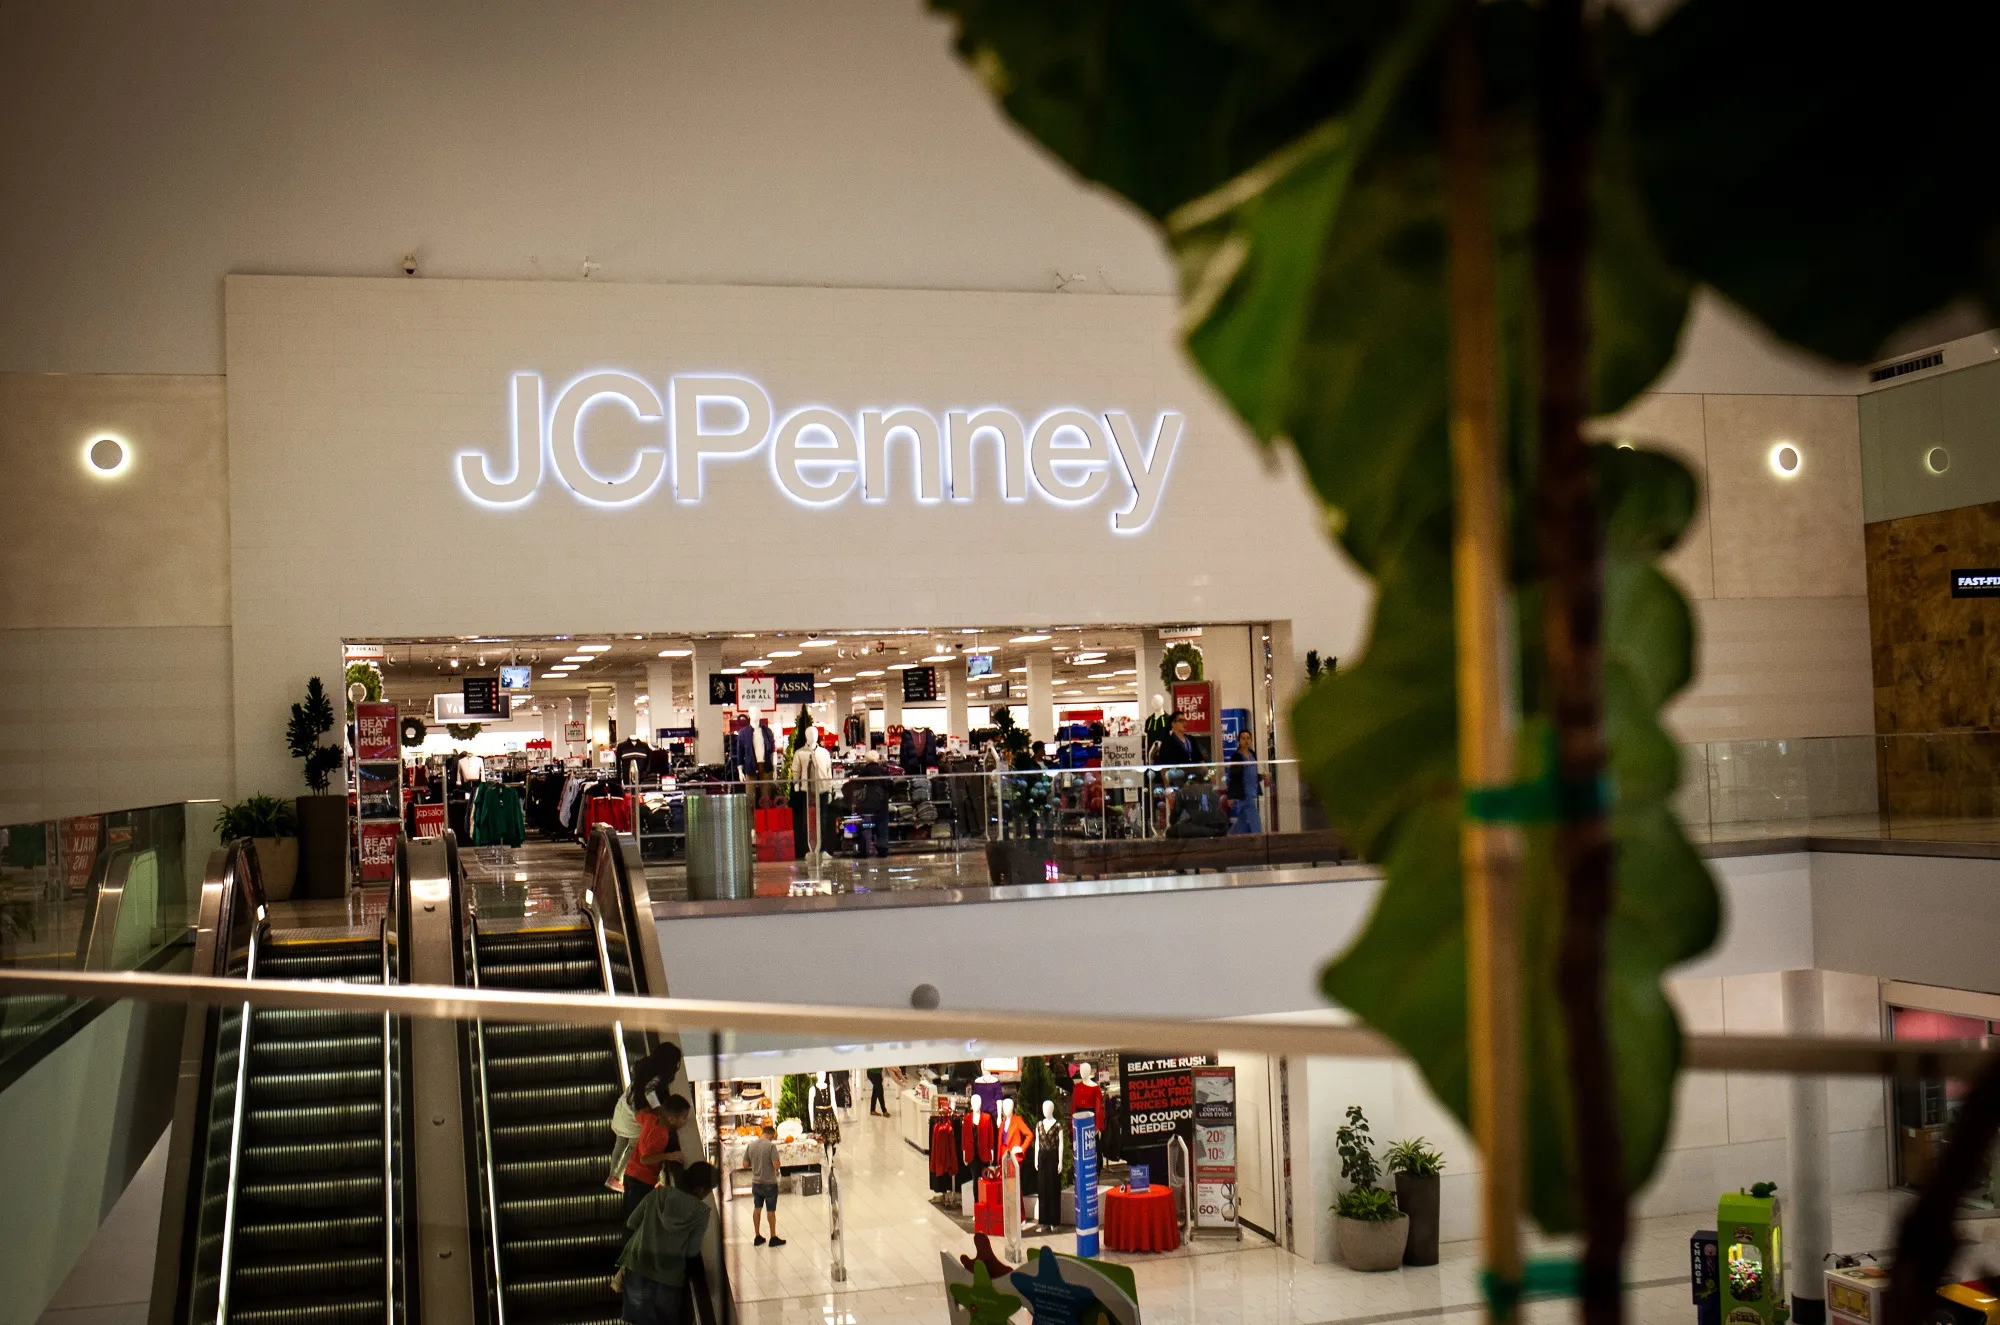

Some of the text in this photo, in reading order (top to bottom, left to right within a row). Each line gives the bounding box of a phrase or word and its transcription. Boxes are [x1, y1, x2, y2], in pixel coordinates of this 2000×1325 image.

[460, 371, 1183, 530] JCPenney
[781, 681, 812, 692] ASSN.
[1177, 696, 1203, 705] BEAT
[1184, 711, 1206, 720] USH
[360, 718, 389, 728] BEAT
[361, 727, 382, 736] THE
[360, 737, 391, 746] RUSH
[1110, 751, 1136, 759] Doctor
[416, 808, 428, 819] jcp
[420, 822, 446, 838] WALK
[363, 836, 393, 847] BEAT
[364, 846, 387, 855] THE
[364, 855, 395, 865] RUSH
[1127, 1055, 1206, 1072] BEAT THE RUSH
[1128, 1076, 1192, 1090] ROLLING OU
[1129, 1086, 1192, 1101] BLACK FRID
[1130, 1099, 1169, 1112] PRICES
[1130, 1109, 1193, 1125] NO COUPON
[1130, 1121, 1176, 1135] NEEDED
[1084, 1129, 1096, 1139] No
[1694, 1242, 1702, 1285] CHANGE
